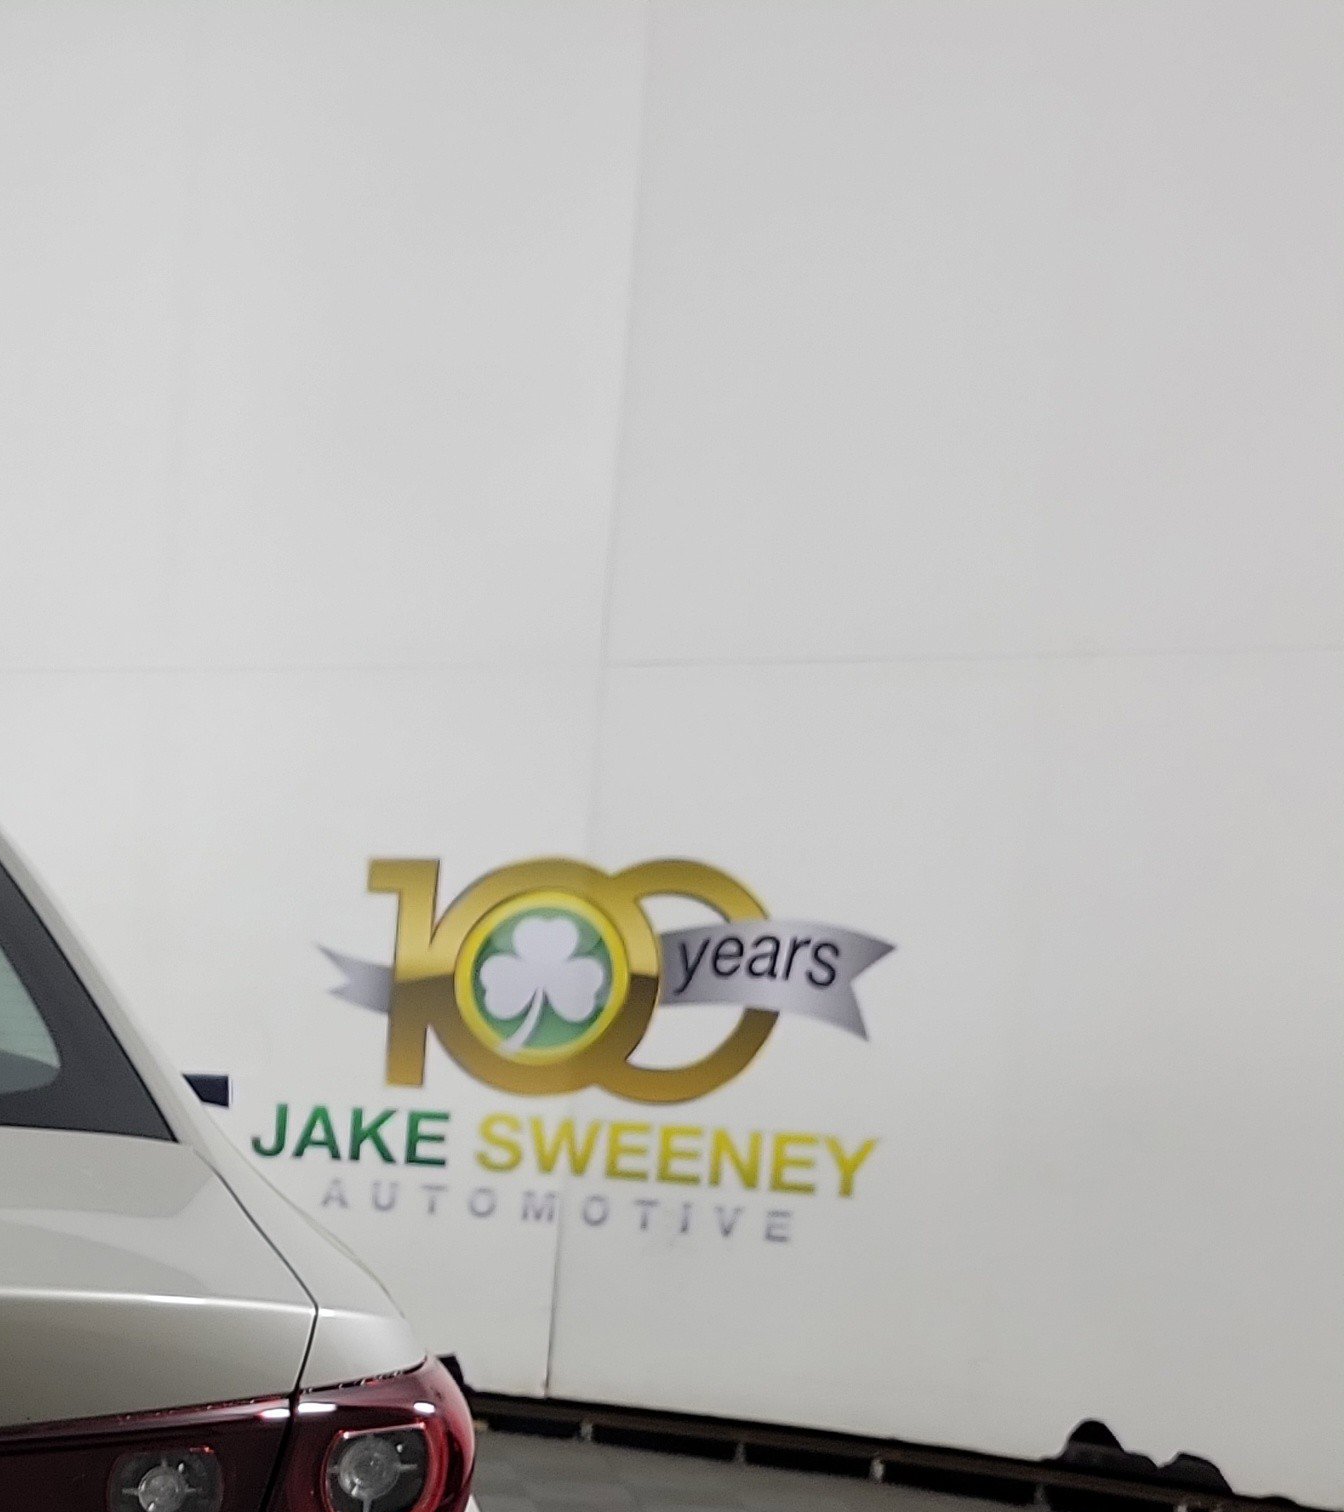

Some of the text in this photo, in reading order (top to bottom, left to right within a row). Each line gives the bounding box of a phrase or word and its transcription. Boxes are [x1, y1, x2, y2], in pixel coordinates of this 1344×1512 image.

[367, 858, 841, 1106] 100 years
[251, 1102, 876, 1198] JAKE SWEENEY
[320, 1178, 793, 1243] AUTOMOTIVE
